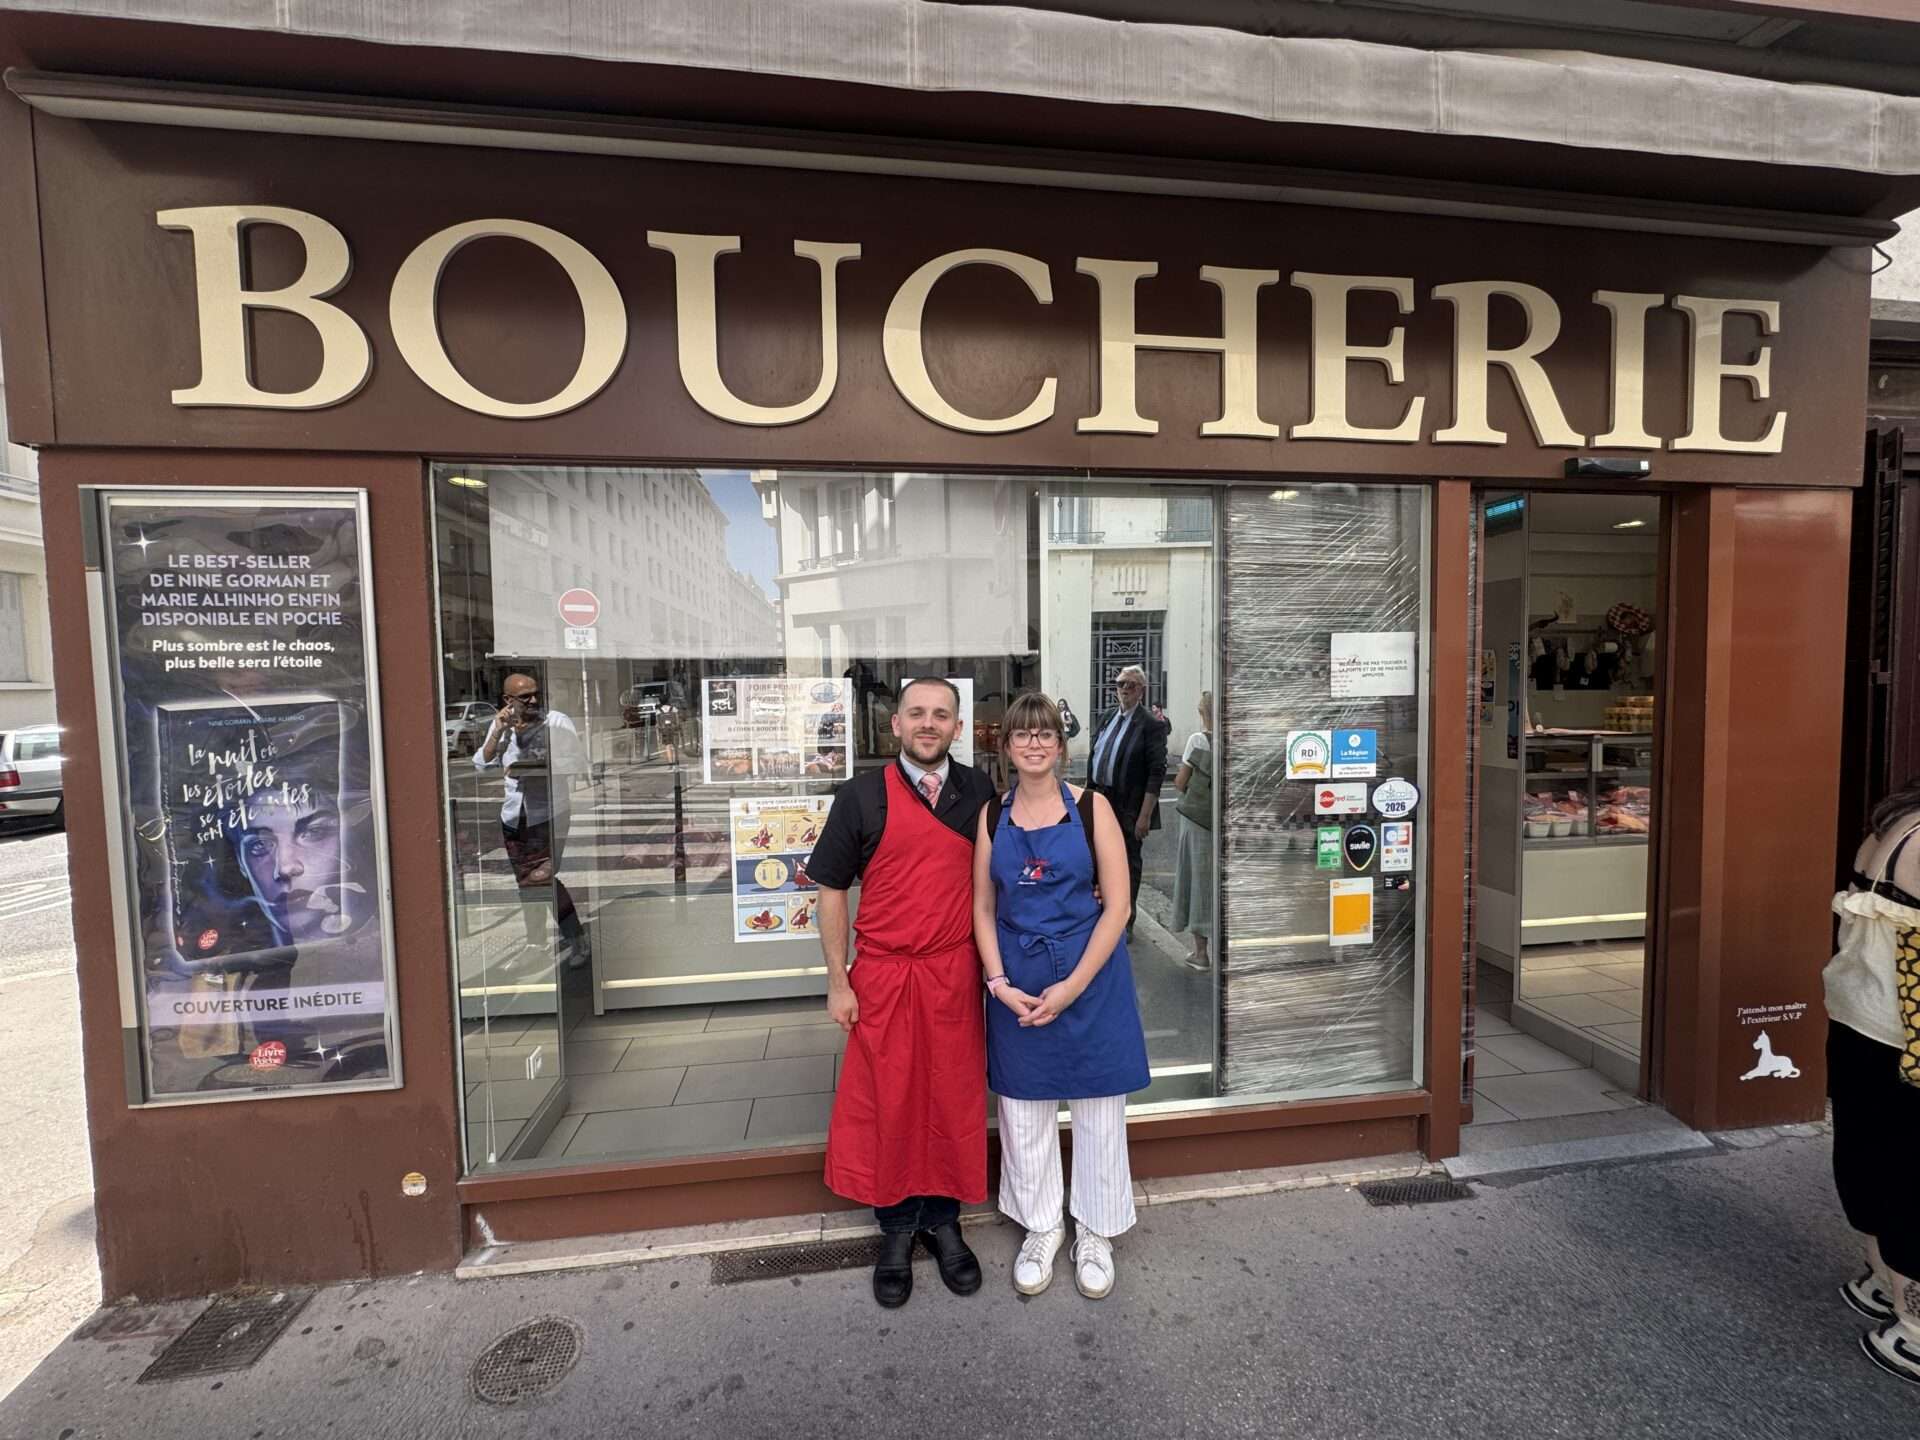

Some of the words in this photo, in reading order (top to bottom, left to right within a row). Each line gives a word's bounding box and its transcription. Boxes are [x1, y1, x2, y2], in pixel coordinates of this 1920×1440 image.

[156, 205, 1787, 454] BOUCHERIE
[168, 555, 190, 568] LE
[194, 554, 311, 569] BEST-SELLER
[151, 574, 174, 588] DE
[178, 573, 223, 588] NINE
[226, 573, 306, 588] GORMAN
[310, 574, 331, 588] ET
[141, 593, 198, 607] MARIE
[202, 593, 284, 607] ALHINHO
[288, 593, 341, 607] ENFIN
[142, 612, 250, 626] DISPONIBLE
[254, 612, 279, 625] EN
[282, 611, 342, 625] POCHE
[152, 639, 184, 652] Plus
[187, 639, 243, 652] sombre
[246, 641, 270, 652] est
[272, 639, 286, 651] le
[288, 639, 335, 653] chaos,
[165, 657, 196, 672] plus
[199, 656, 235, 669] belle
[238, 659, 268, 669] sera
[188, 743, 206, 767] La
[208, 728, 258, 776] nuit
[182, 783, 202, 803] les
[203, 764, 280, 810] étoiles
[1385, 802, 1406, 812] 2026
[196, 818, 224, 845] sont
[173, 996, 289, 1015] COUVERTURE
[293, 991, 363, 1009] INÉDITE
[258, 1046, 285, 1058] Livre
